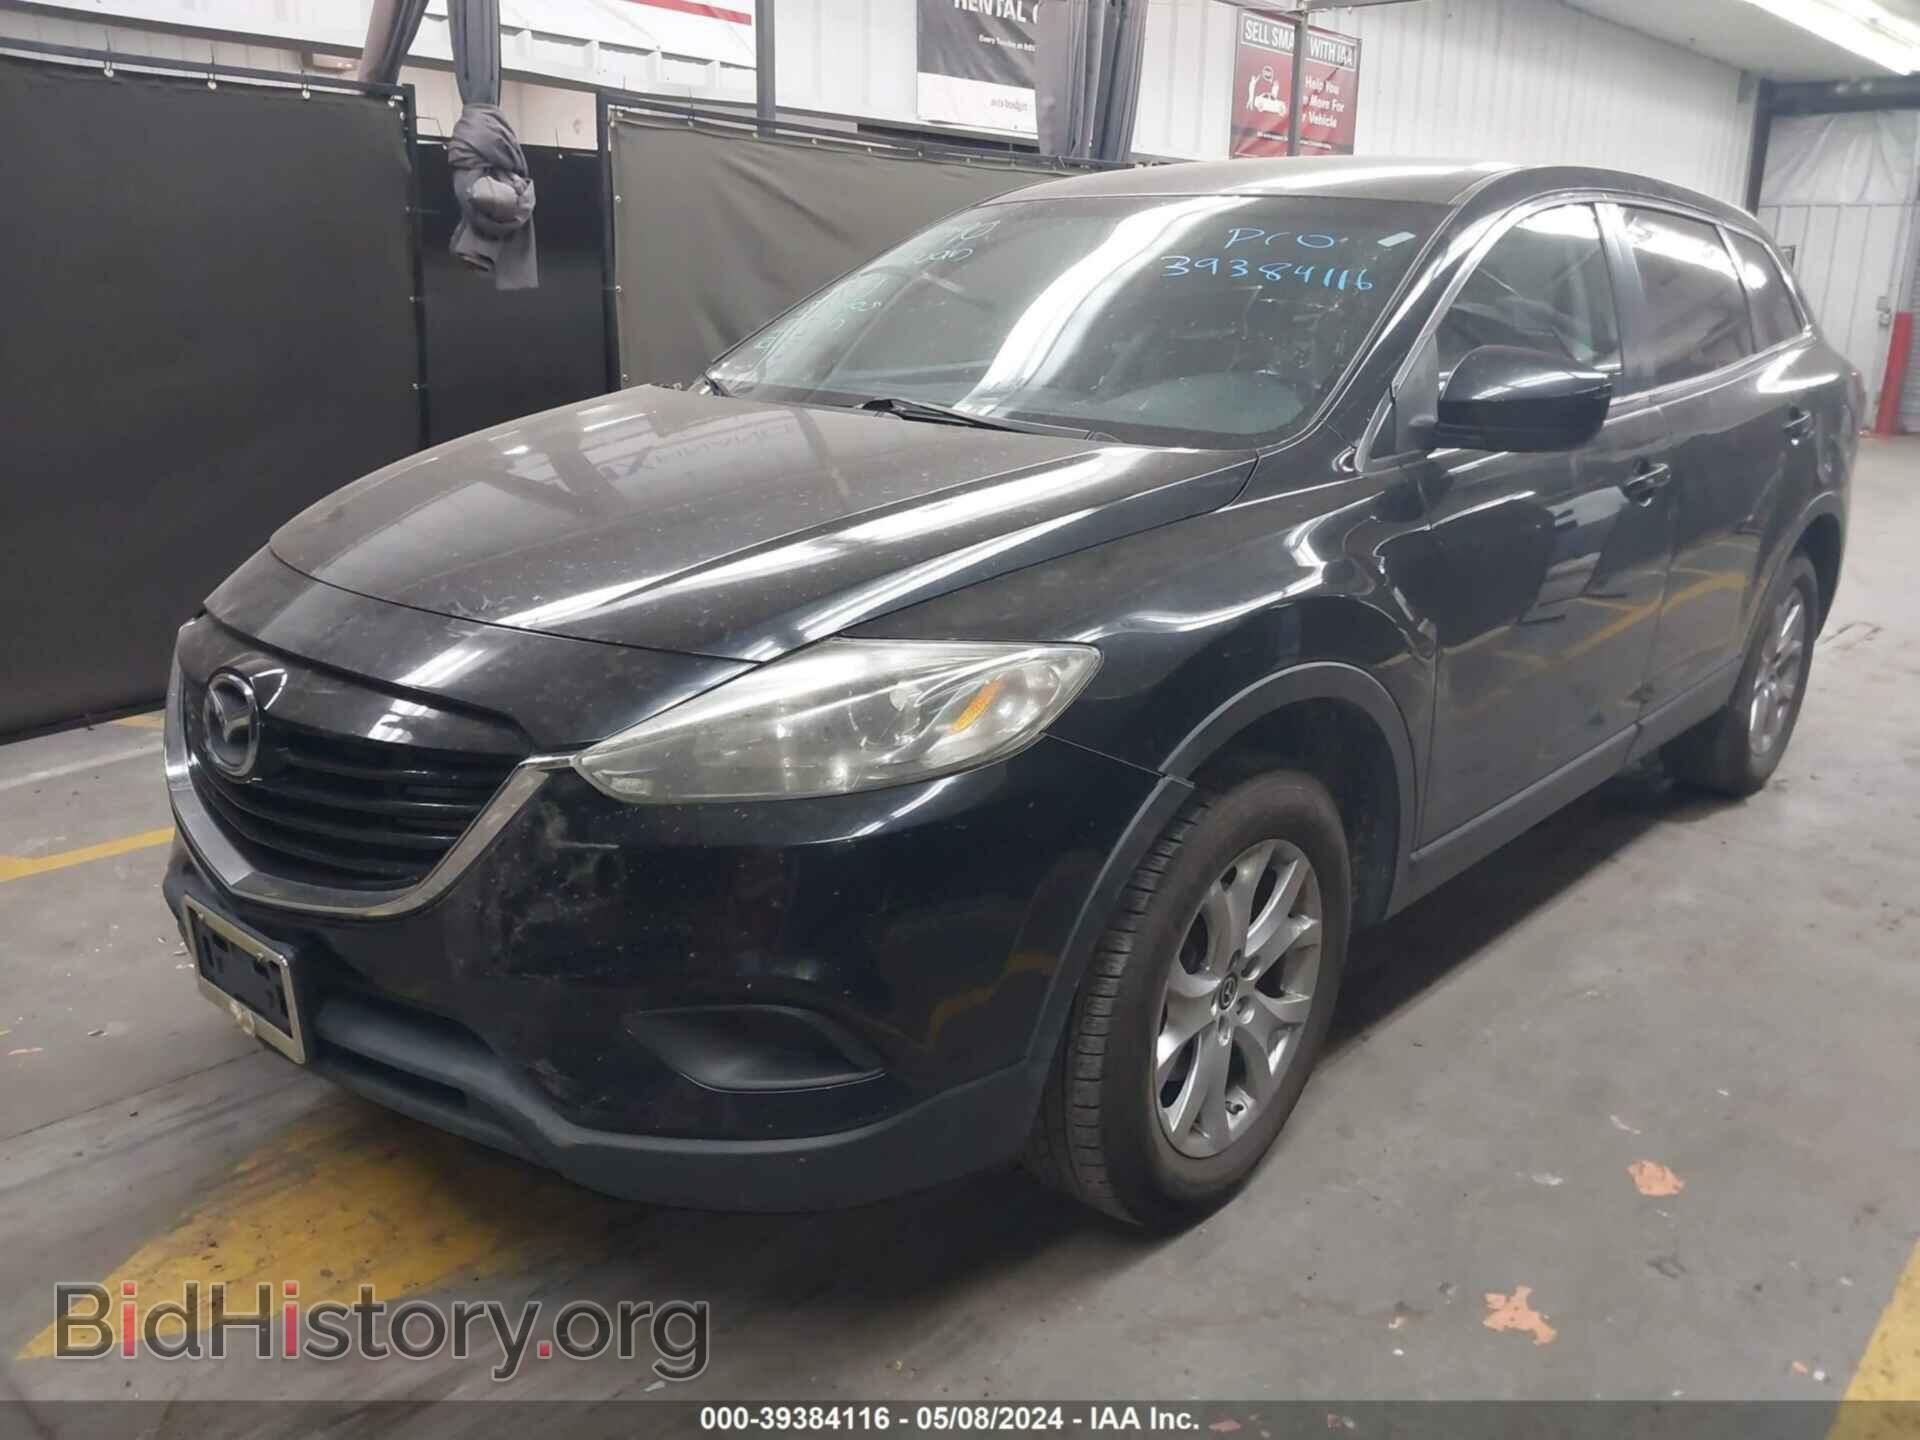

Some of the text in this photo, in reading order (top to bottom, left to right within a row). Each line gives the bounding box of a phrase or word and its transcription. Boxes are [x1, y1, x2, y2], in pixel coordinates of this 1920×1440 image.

[1244, 19, 1270, 45] SELL
[1271, 27, 1297, 51] SMA
[1309, 37, 1336, 62] WITH
[1308, 111, 1337, 129] Vehicle
[1160, 255, 1374, 291] 39384116
